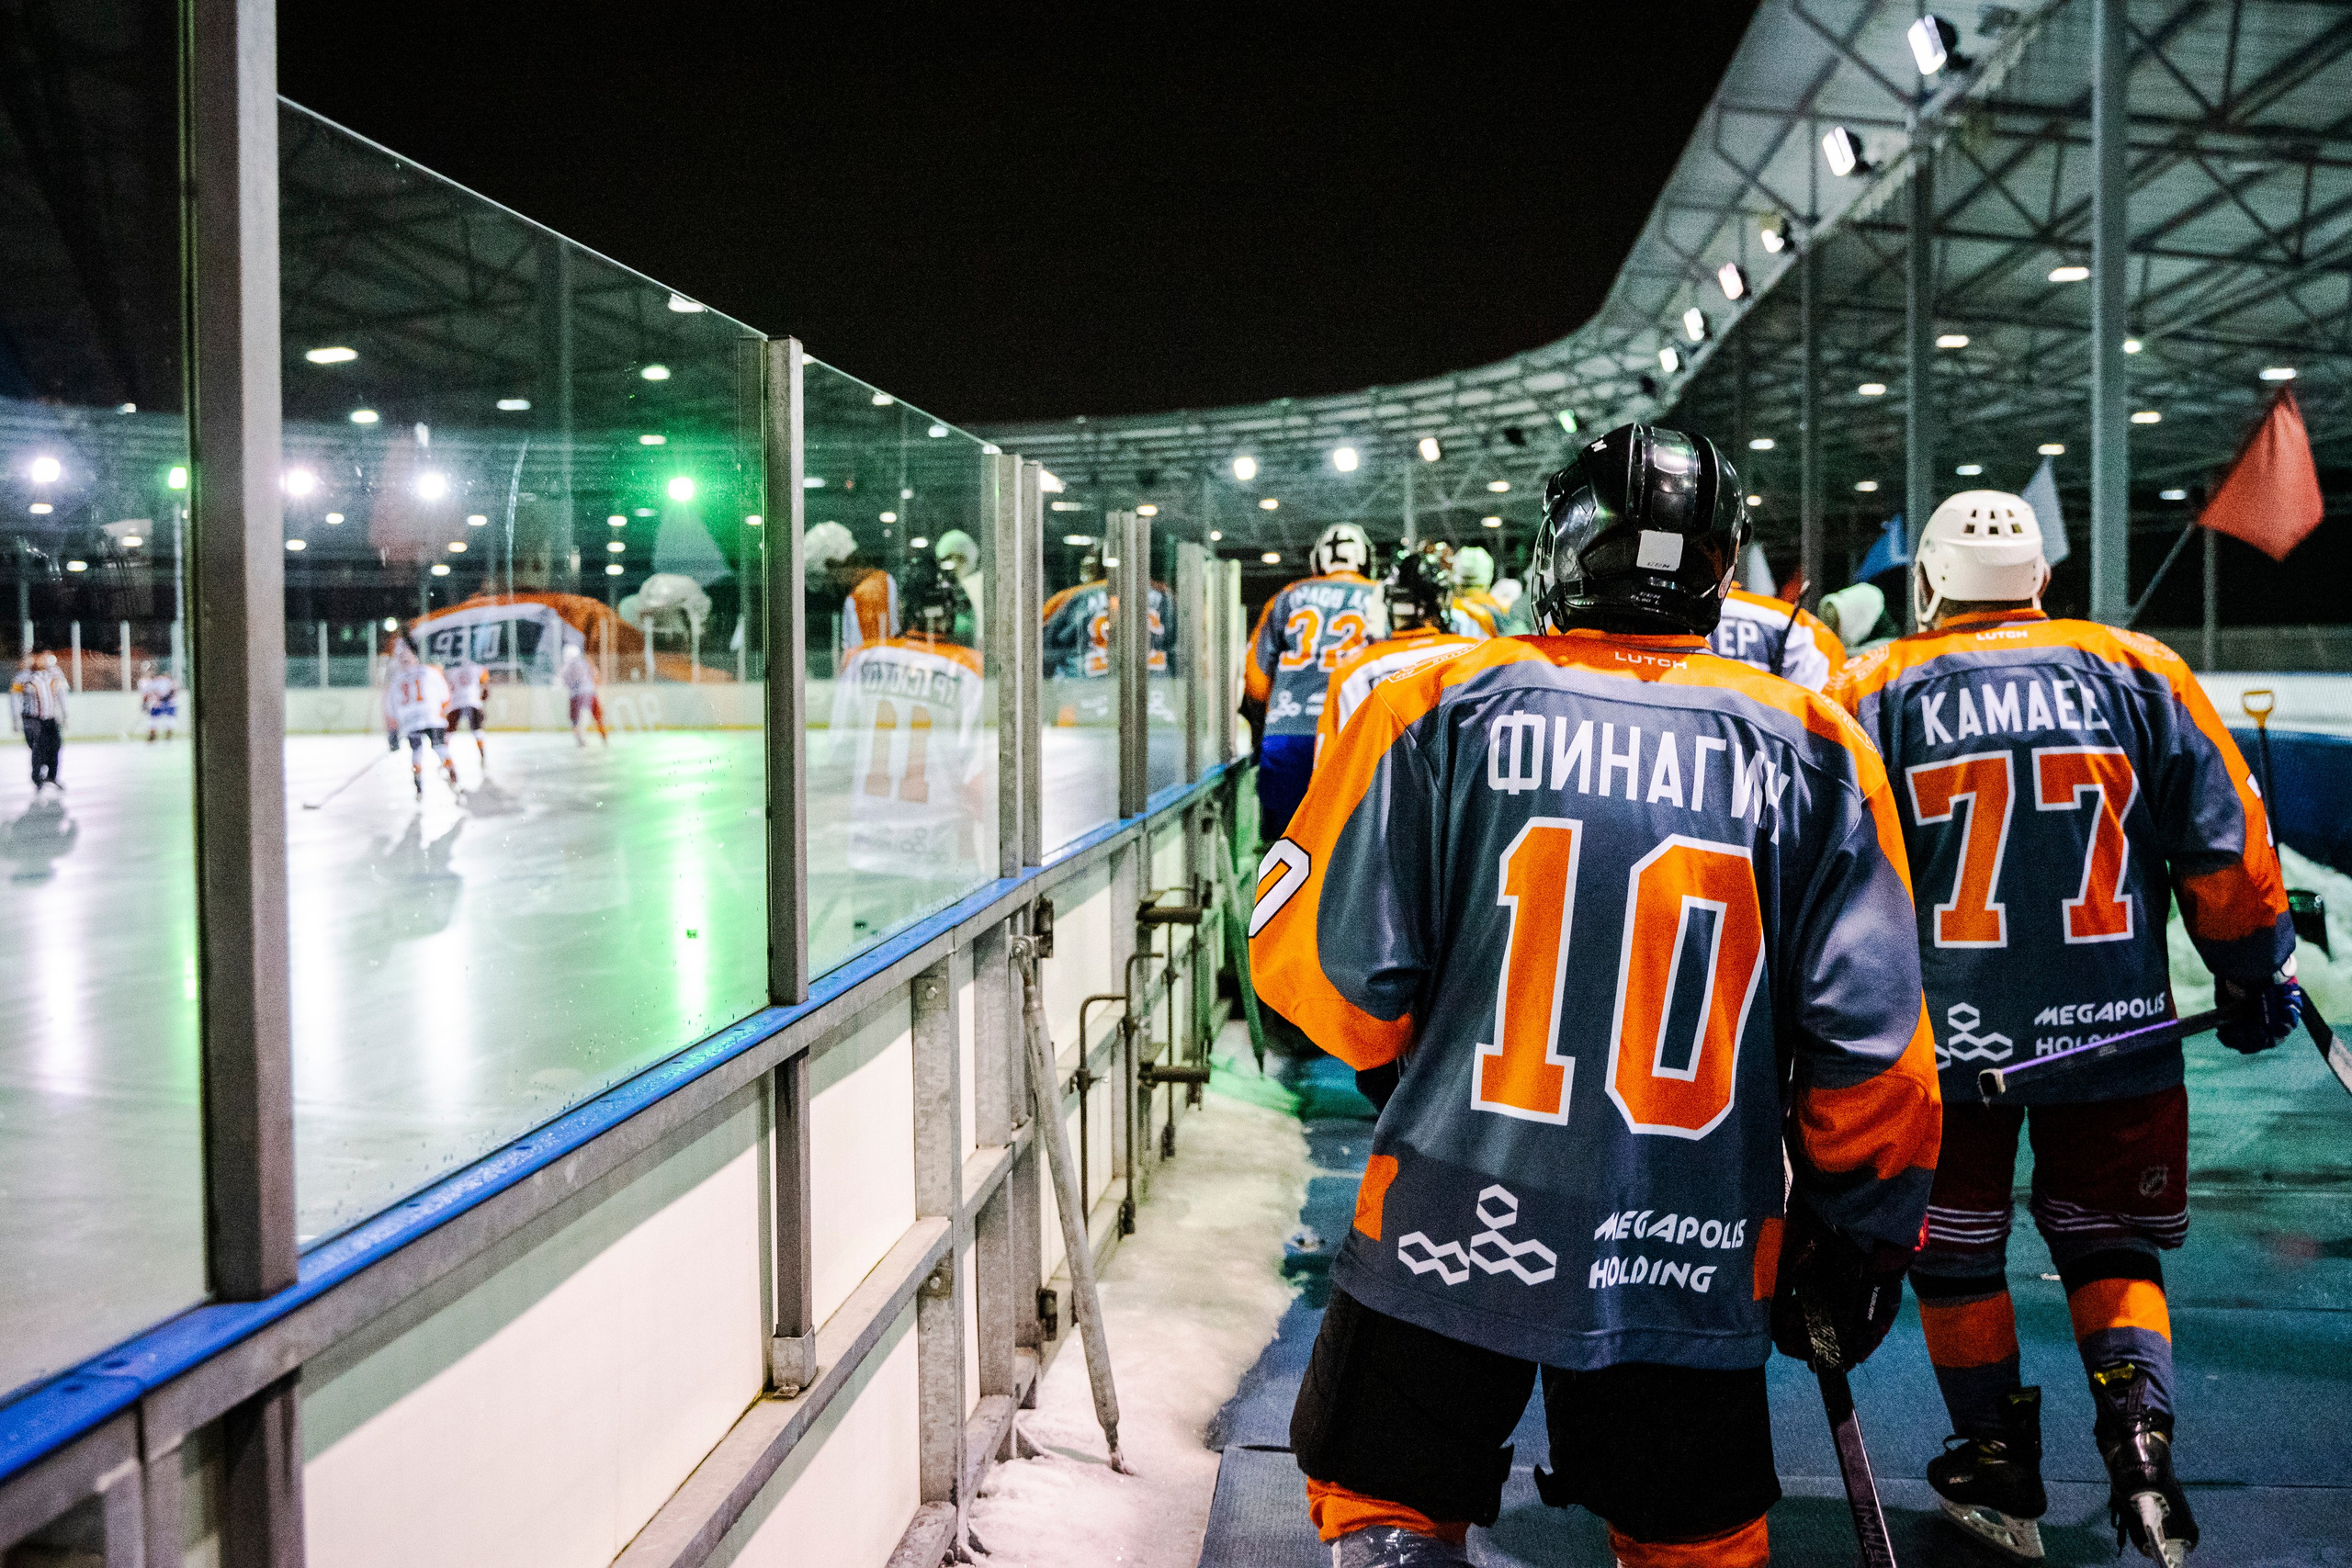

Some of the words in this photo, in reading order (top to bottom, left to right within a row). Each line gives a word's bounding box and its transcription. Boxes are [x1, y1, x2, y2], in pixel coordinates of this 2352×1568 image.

[1277, 604, 1368, 672] 32
[1718, 620, 1758, 657] ЕР
[1976, 630, 2029, 641] LUTCH
[1614, 651, 1688, 670] LUTCH
[1905, 746, 2139, 949] 77
[1471, 817, 1765, 1141] 10
[2033, 991, 2166, 1027] MEGAPOLIS
[1594, 1210, 1747, 1249] MEGAPOLIS
[1588, 1255, 1718, 1293] HOLDING
